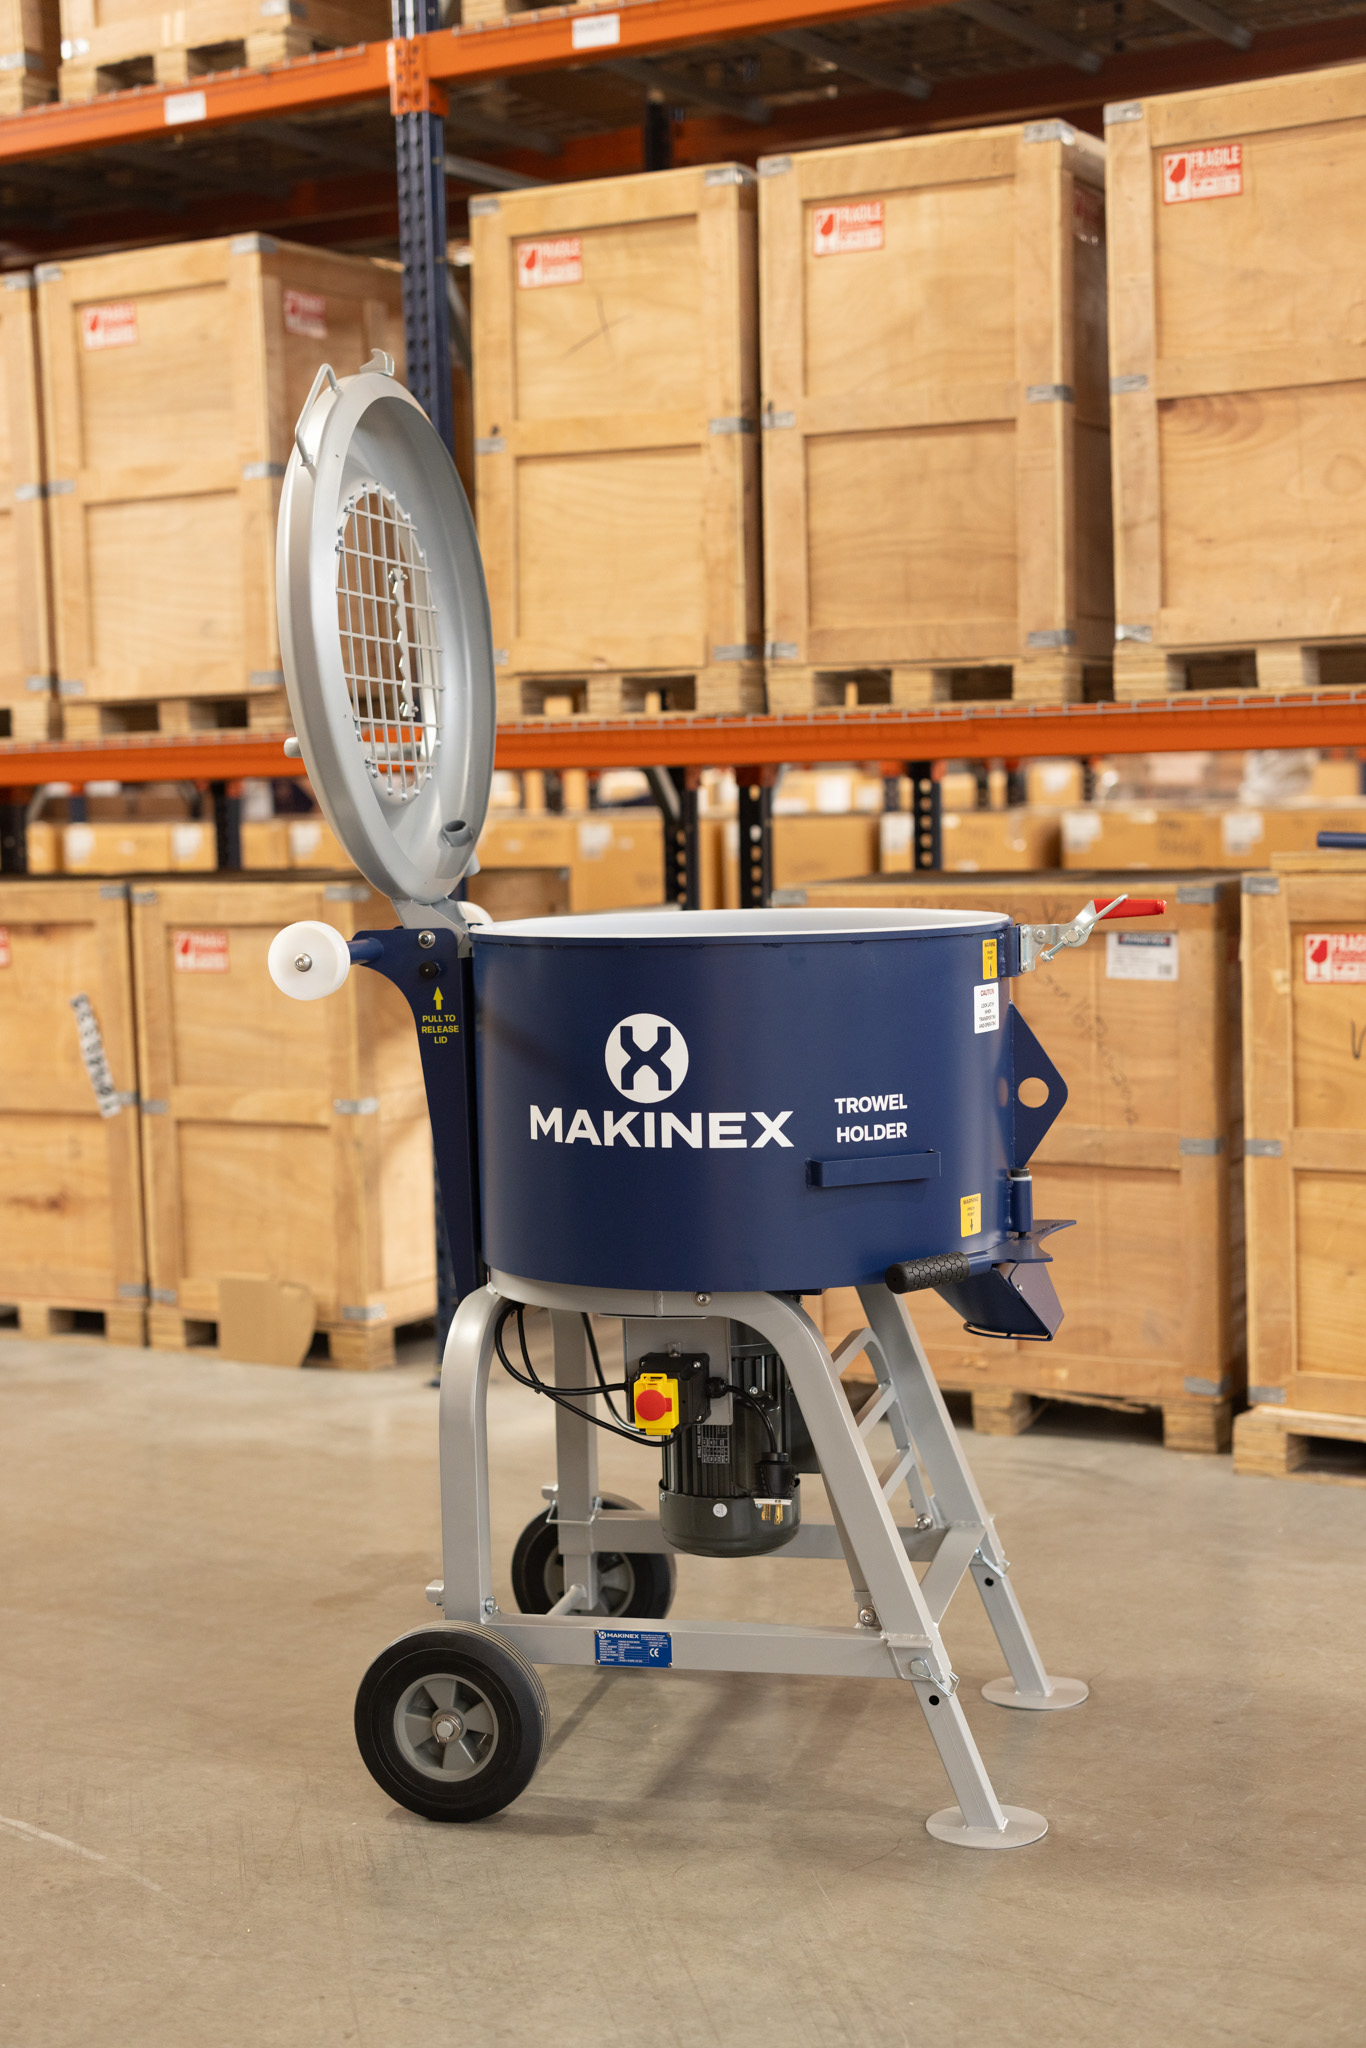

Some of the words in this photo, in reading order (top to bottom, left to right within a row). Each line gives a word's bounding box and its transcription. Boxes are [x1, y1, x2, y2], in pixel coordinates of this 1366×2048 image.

[1190, 146, 1241, 169] FRAGILE
[422, 1015, 443, 1023] PULL
[444, 1014, 456, 1022] TO
[421, 1025, 459, 1034] RELEASE
[434, 1036, 448, 1044] LID
[834, 1093, 908, 1115] TROWEL
[529, 1104, 795, 1149] MAKINEX
[836, 1122, 908, 1143] HOLDER
